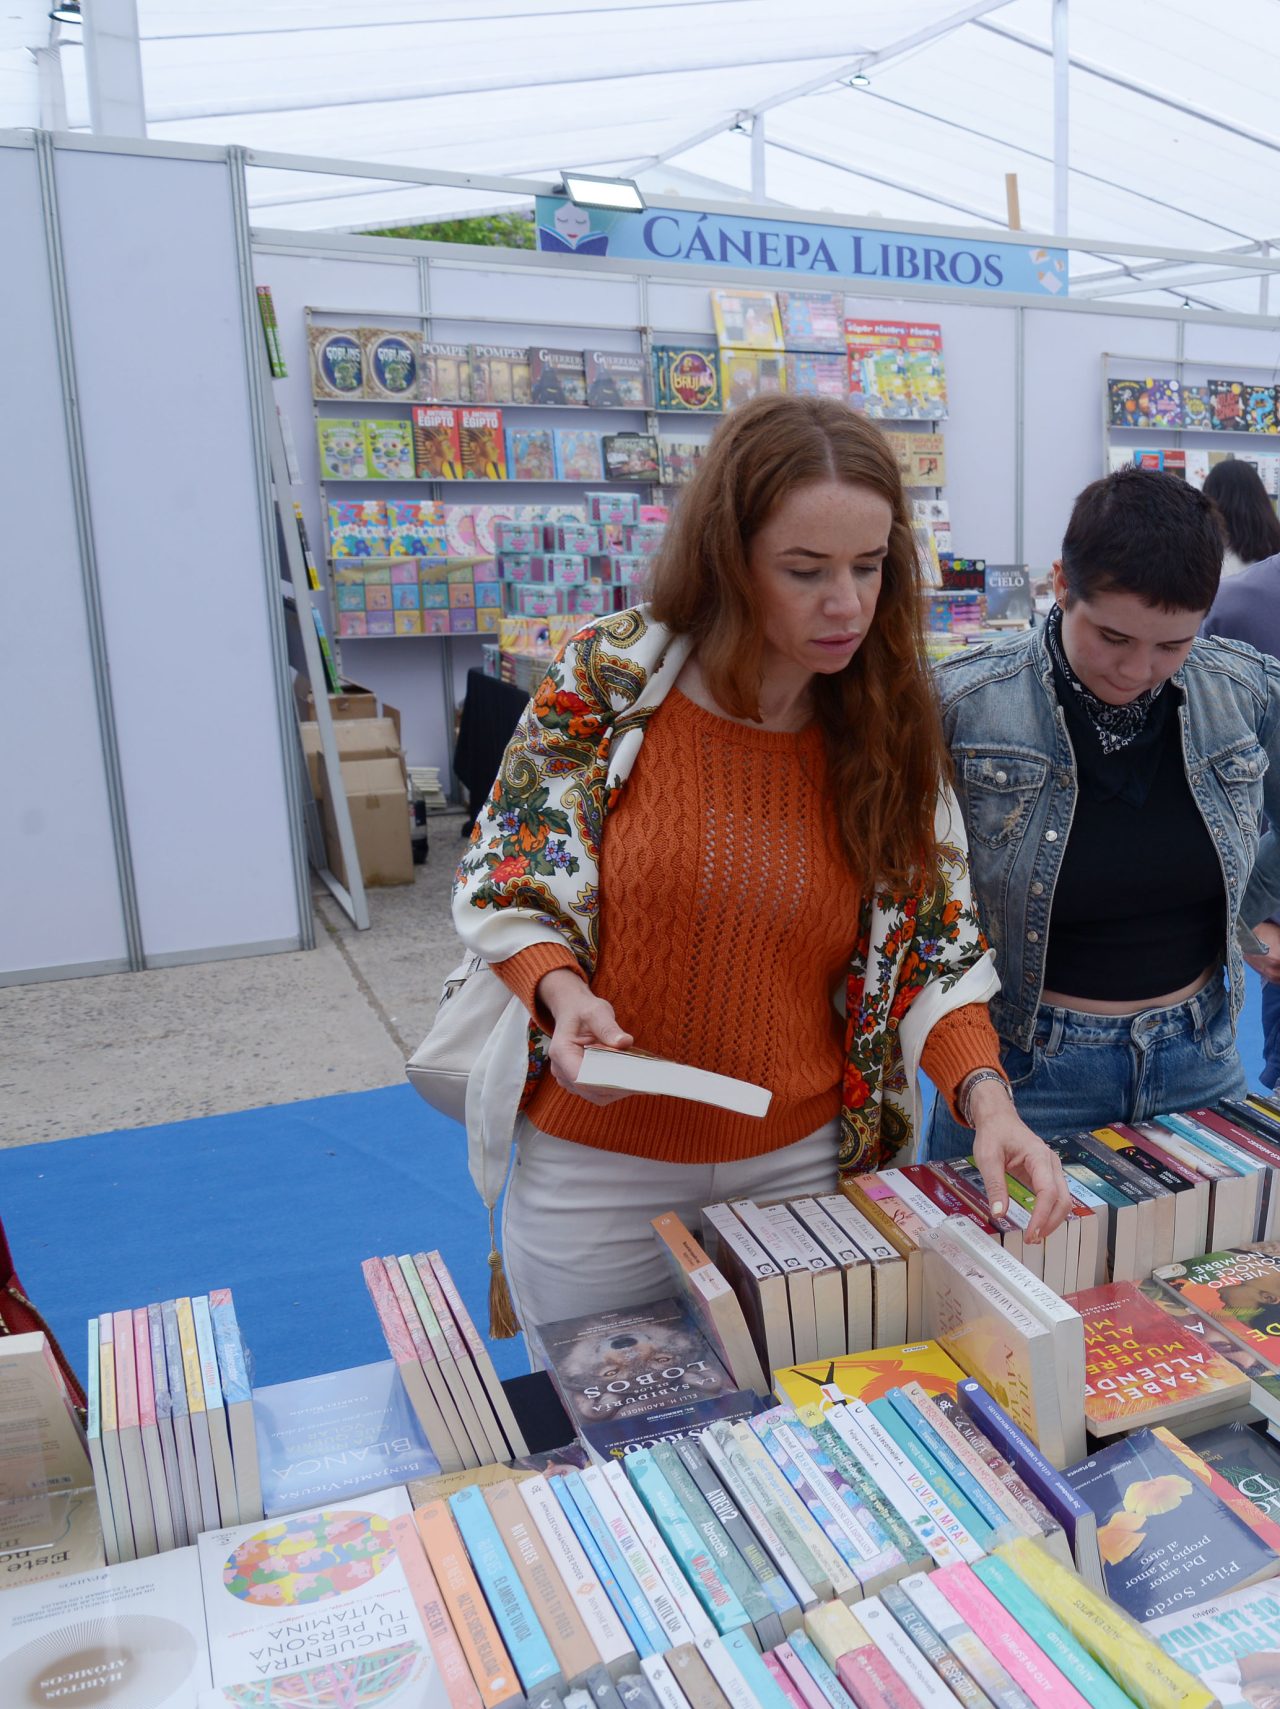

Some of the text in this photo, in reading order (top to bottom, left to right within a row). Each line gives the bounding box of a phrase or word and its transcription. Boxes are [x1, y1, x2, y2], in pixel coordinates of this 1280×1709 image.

[643, 214, 1003, 287] CÁNEPA LIBROS
[377, 347, 411, 363] GOBLINS
[422, 344, 468, 356] POMPE
[417, 416, 454, 427] EGIPTO
[463, 417, 498, 428] EGIPTO
[989, 576, 1024, 587] CIELO
[1120, 1183, 1134, 1195] ISABEL
[1123, 1180, 1142, 1196] ALLENDE
[1158, 1172, 1172, 1184] ISABEL
[1162, 1169, 1181, 1185] ALLENDE
[990, 1249, 1032, 1287] NAVARRO
[1191, 1248, 1265, 1275] NOMBRE
[1188, 1273, 1210, 1284] MI
[1206, 1268, 1266, 1290] VIENTO
[981, 1279, 1014, 1309] NAVARRO
[1083, 1324, 1133, 1346] ALM
[1088, 1337, 1138, 1360] DEL
[1084, 1338, 1183, 1374] MUJERE
[582, 1359, 709, 1399] LOBOS
[697, 1376, 716, 1386] LA
[1081, 1351, 1204, 1397] ALLENDE
[1104, 1366, 1208, 1406] ISABEL
[592, 1382, 689, 1414] SABIDURÍA
[633, 1385, 652, 1394] LOS
[679, 1392, 697, 1402] ELLI
[619, 1401, 664, 1417] RADINGER
[847, 1428, 861, 1442] Felipe
[271, 1436, 411, 1481] BLANCA
[962, 1427, 988, 1454] MAGIA
[999, 1471, 1027, 1502] RHONDA
[1066, 1463, 1088, 1477] Planeta
[868, 1423, 884, 1441] Felipe
[906, 1472, 937, 1508] VOLVER
[932, 1506, 943, 1516] A
[939, 1513, 969, 1546] MIRAR
[1054, 1480, 1081, 1510] Joy Woodward
[699, 1518, 732, 1558] Abrázate
[705, 1486, 739, 1524] ATREVI2
[744, 1542, 766, 1568] MANUEL
[873, 1498, 913, 1548] vuelta autismo
[537, 1500, 583, 1580] ANIMALES CHAMÁNICOS DE PODER
[1139, 1540, 1179, 1566] al otro
[6, 1550, 71, 1573] Este
[608, 1516, 682, 1633] PENSAR BIEN, SENTIRSE WALTER RISO
[1123, 1534, 1211, 1589] propio al amor
[1147, 1552, 1206, 1590] Del amor
[510, 1523, 574, 1640] RUT NIEVES RECUPERA TU PODER
[1144, 1558, 1240, 1619] Pilar Sordo
[267, 1600, 384, 1641] VITAMINA
[422, 1599, 448, 1638] CREE EN TI
[493, 1575, 531, 1642] EL AMOR DE TU VIDA
[1191, 1605, 1218, 1619] URANO
[1209, 1608, 1252, 1634] LA
[248, 1608, 408, 1661] TU PERSONA
[455, 1591, 500, 1678] HAZ TUS SUEÑOS REALIDAD
[885, 1630, 902, 1647] Daniel
[1092, 1614, 1121, 1641] ALTO EN
[255, 1624, 406, 1675] ENCUENTRA
[901, 1612, 977, 1700] EL CAMINO DEL DESPERTAR
[999, 1631, 1053, 1691] ALTO EN ESPÍRITU
[1045, 1629, 1095, 1683] ALTO EN SALUD
[40, 1658, 128, 1688] ATÓMICOS
[45, 1672, 122, 1699] HÁBITOS
